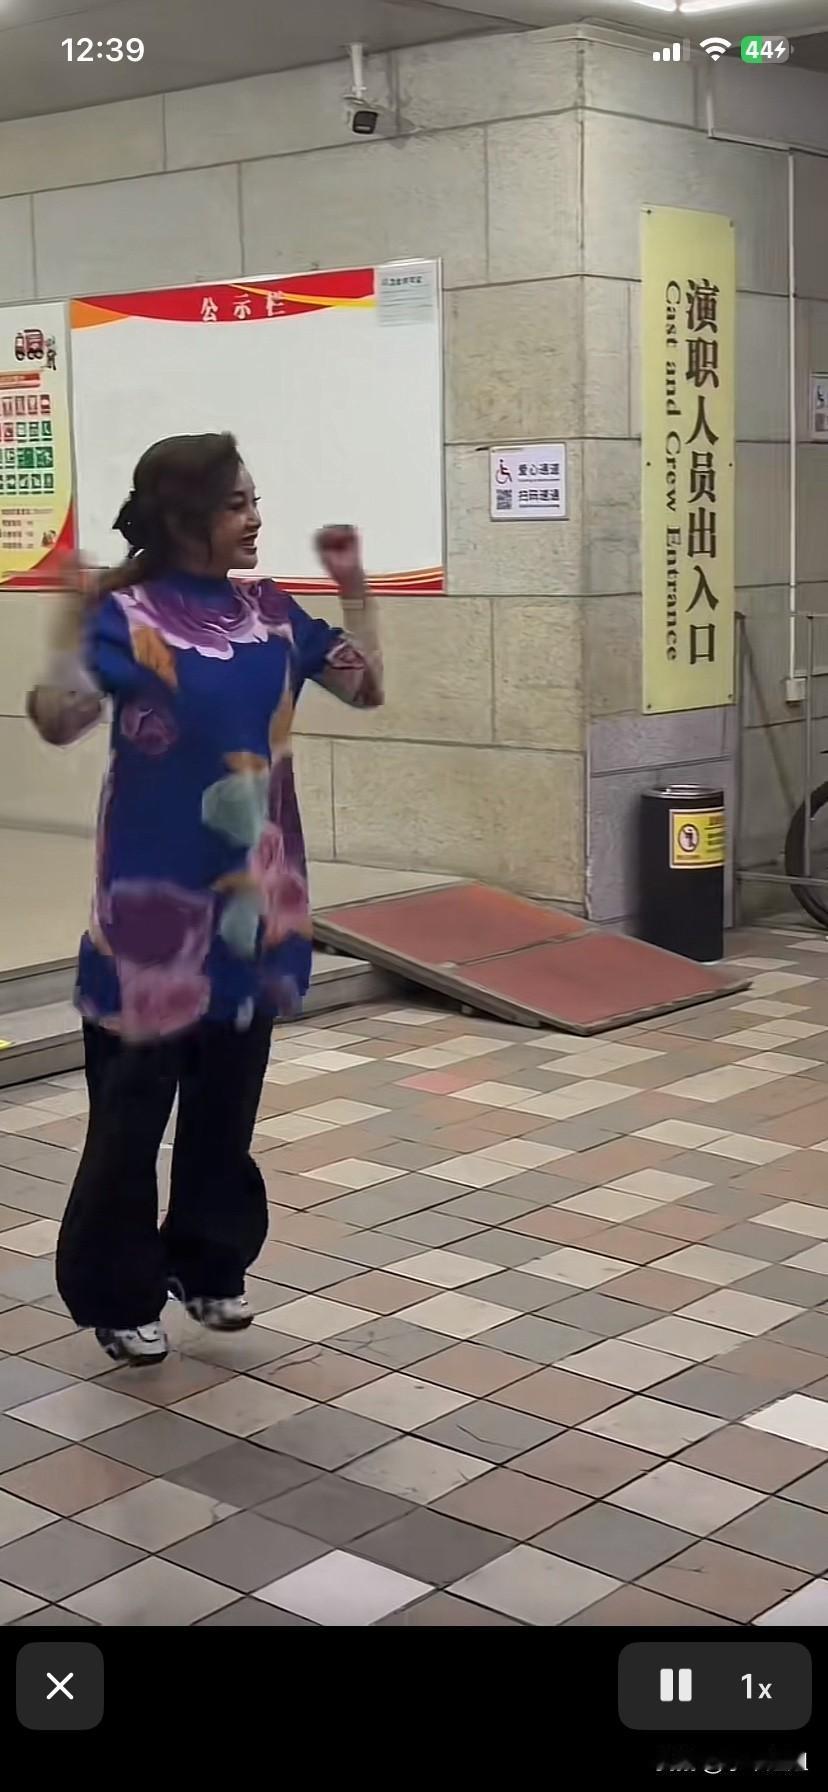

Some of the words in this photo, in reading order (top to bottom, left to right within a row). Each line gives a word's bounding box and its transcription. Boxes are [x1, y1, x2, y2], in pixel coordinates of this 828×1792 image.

[200, 290, 287, 322] 公示栏
[665, 280, 682, 348] Cast
[665, 361, 682, 416] and
[665, 430, 682, 512] Crew
[684, 277, 721, 665] 演职人员出入口
[666, 525, 682, 662] Entrance
